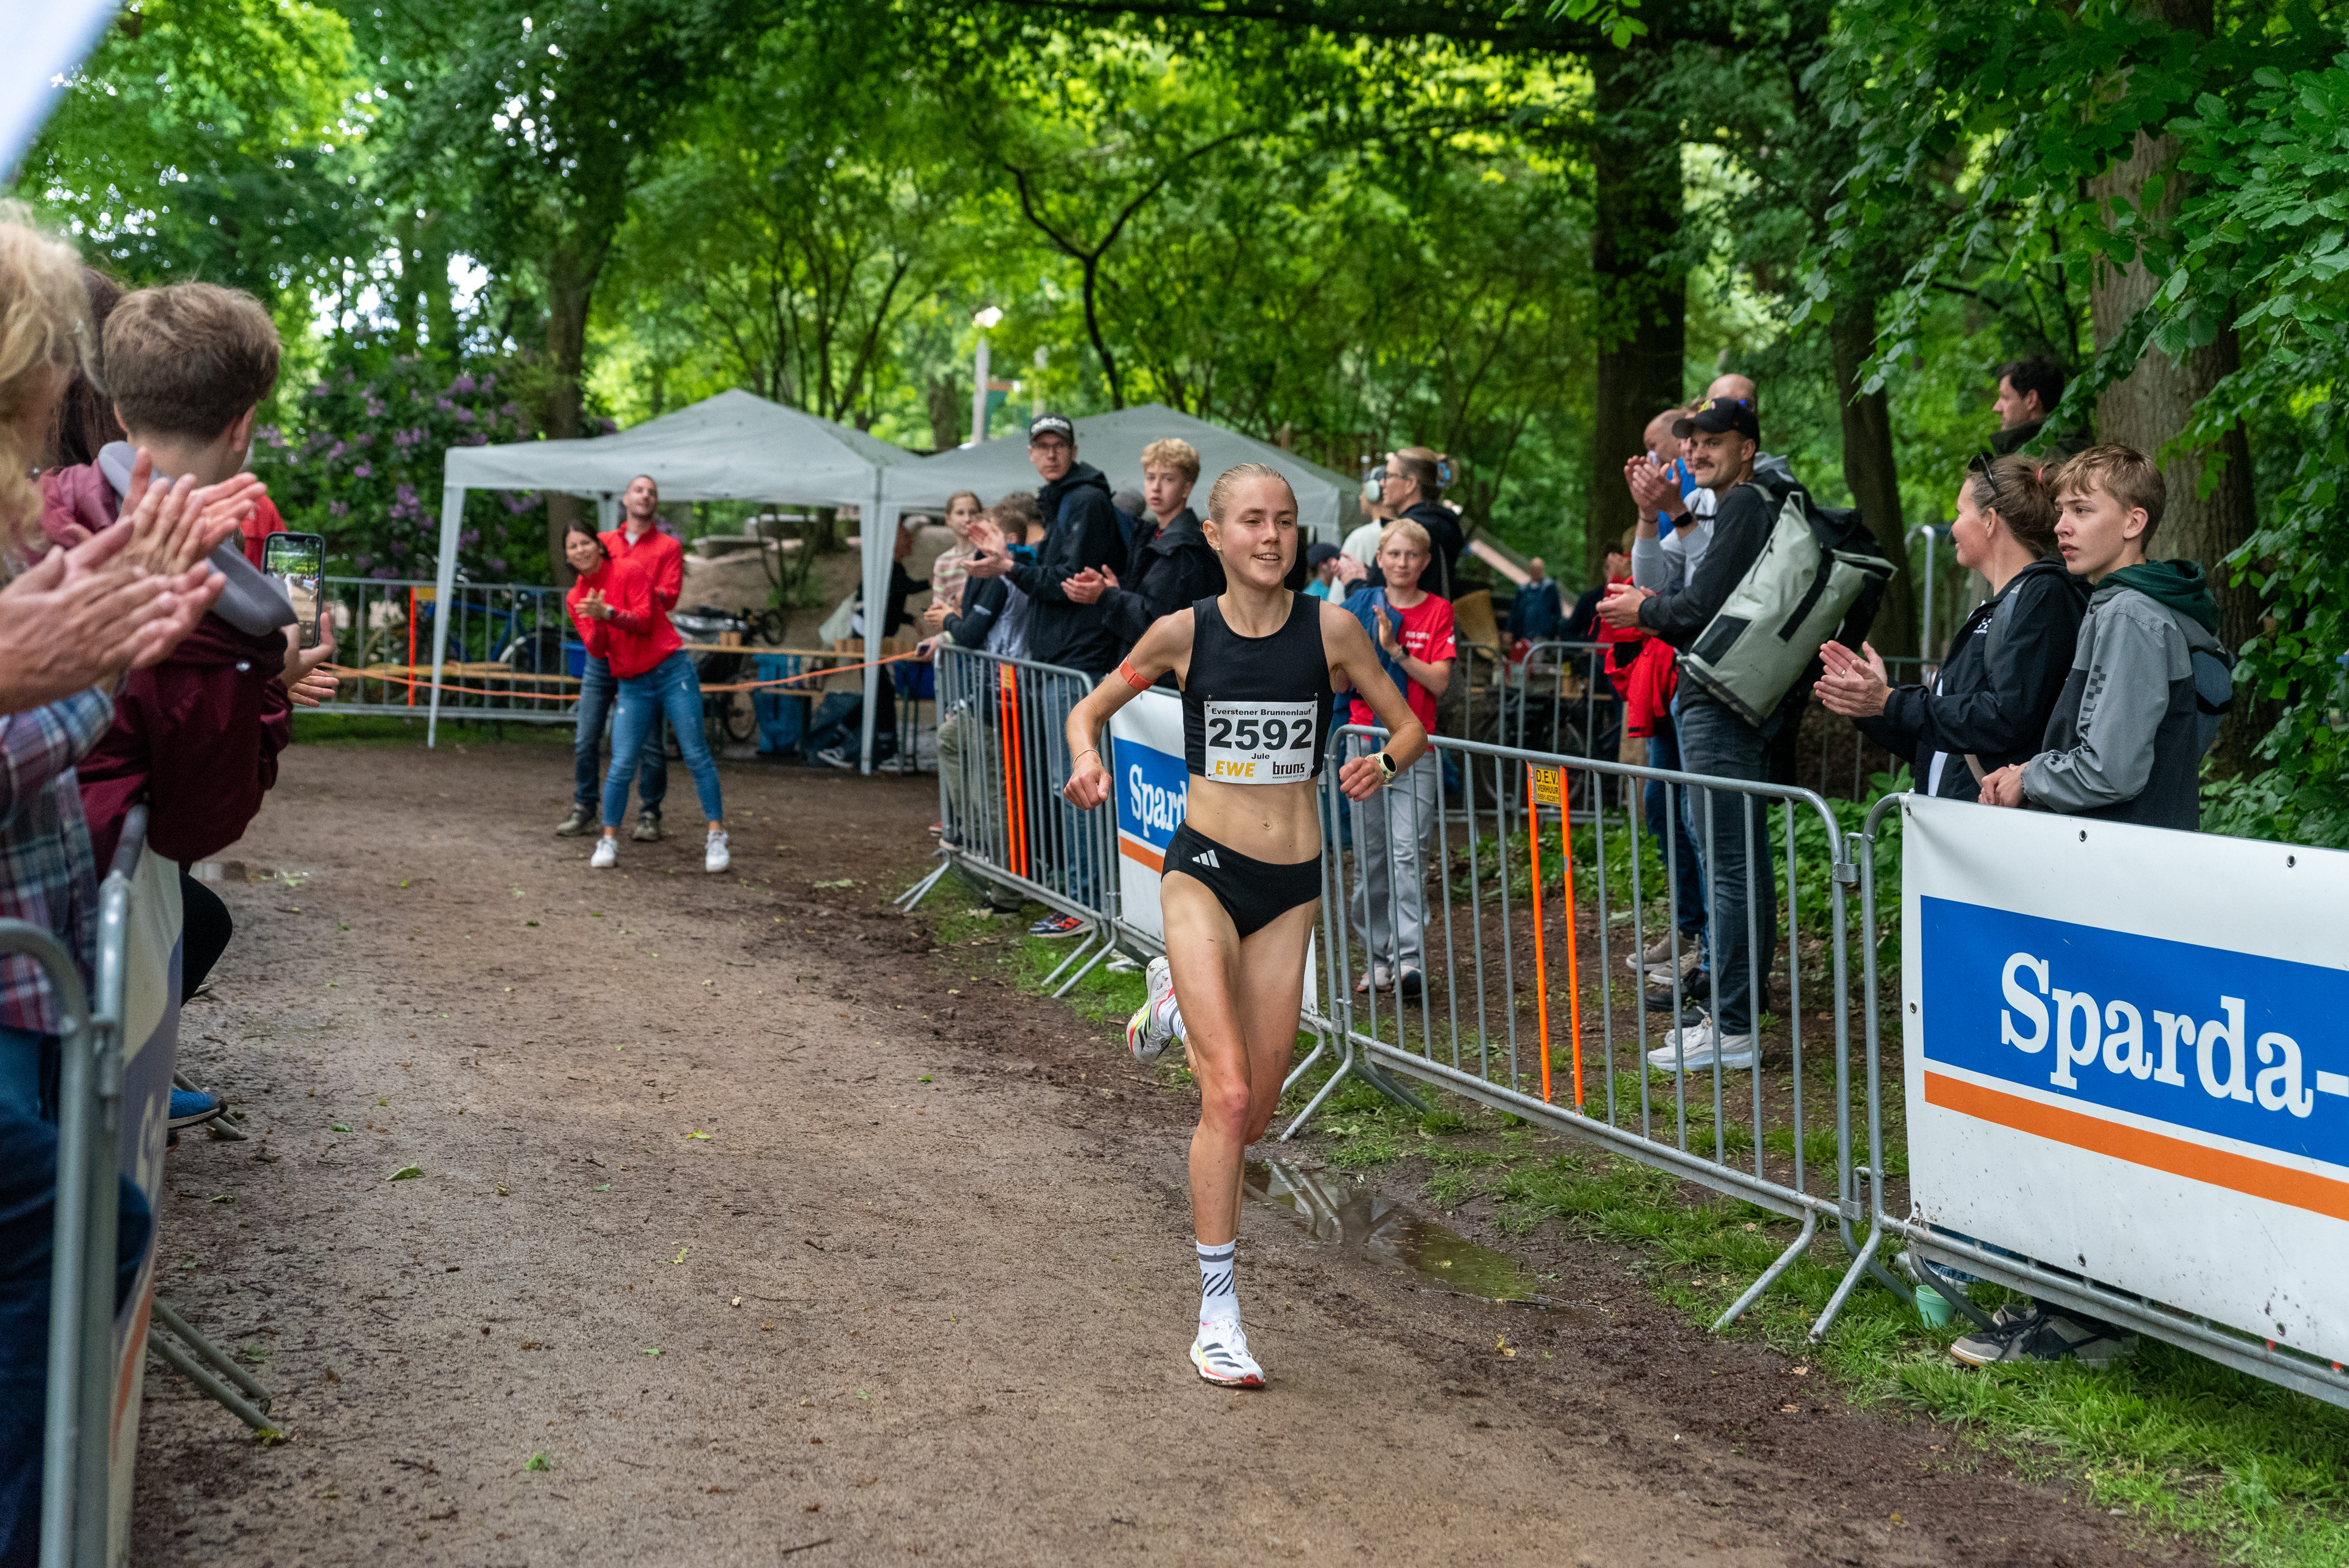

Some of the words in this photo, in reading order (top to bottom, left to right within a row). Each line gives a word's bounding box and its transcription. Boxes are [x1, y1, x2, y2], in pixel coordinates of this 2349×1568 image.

[1208, 718, 1313, 751] 2592
[1215, 760, 1256, 777] EWE
[1273, 761, 1305, 775] bruns
[1536, 769, 1558, 785] D.E.V.
[1537, 784, 1559, 794] VERHUUR
